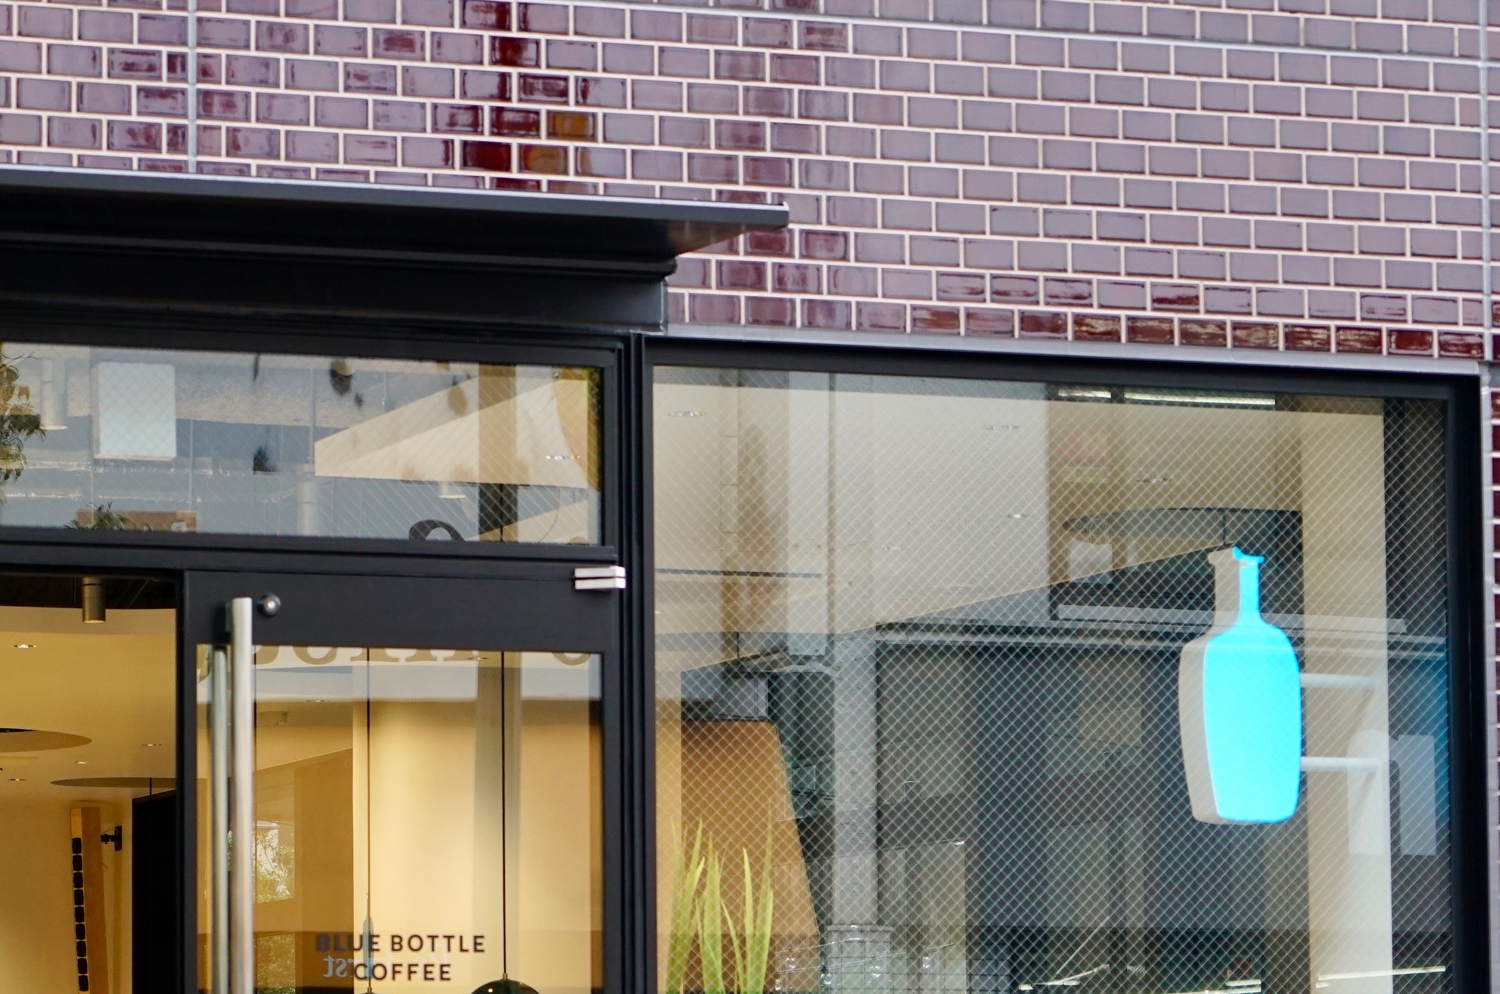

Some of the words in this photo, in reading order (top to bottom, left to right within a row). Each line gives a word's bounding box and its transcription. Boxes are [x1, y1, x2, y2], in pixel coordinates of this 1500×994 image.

[316, 934, 381, 953] BLUE
[391, 934, 485, 953] BOTTLE
[354, 963, 451, 981] COFFEE
